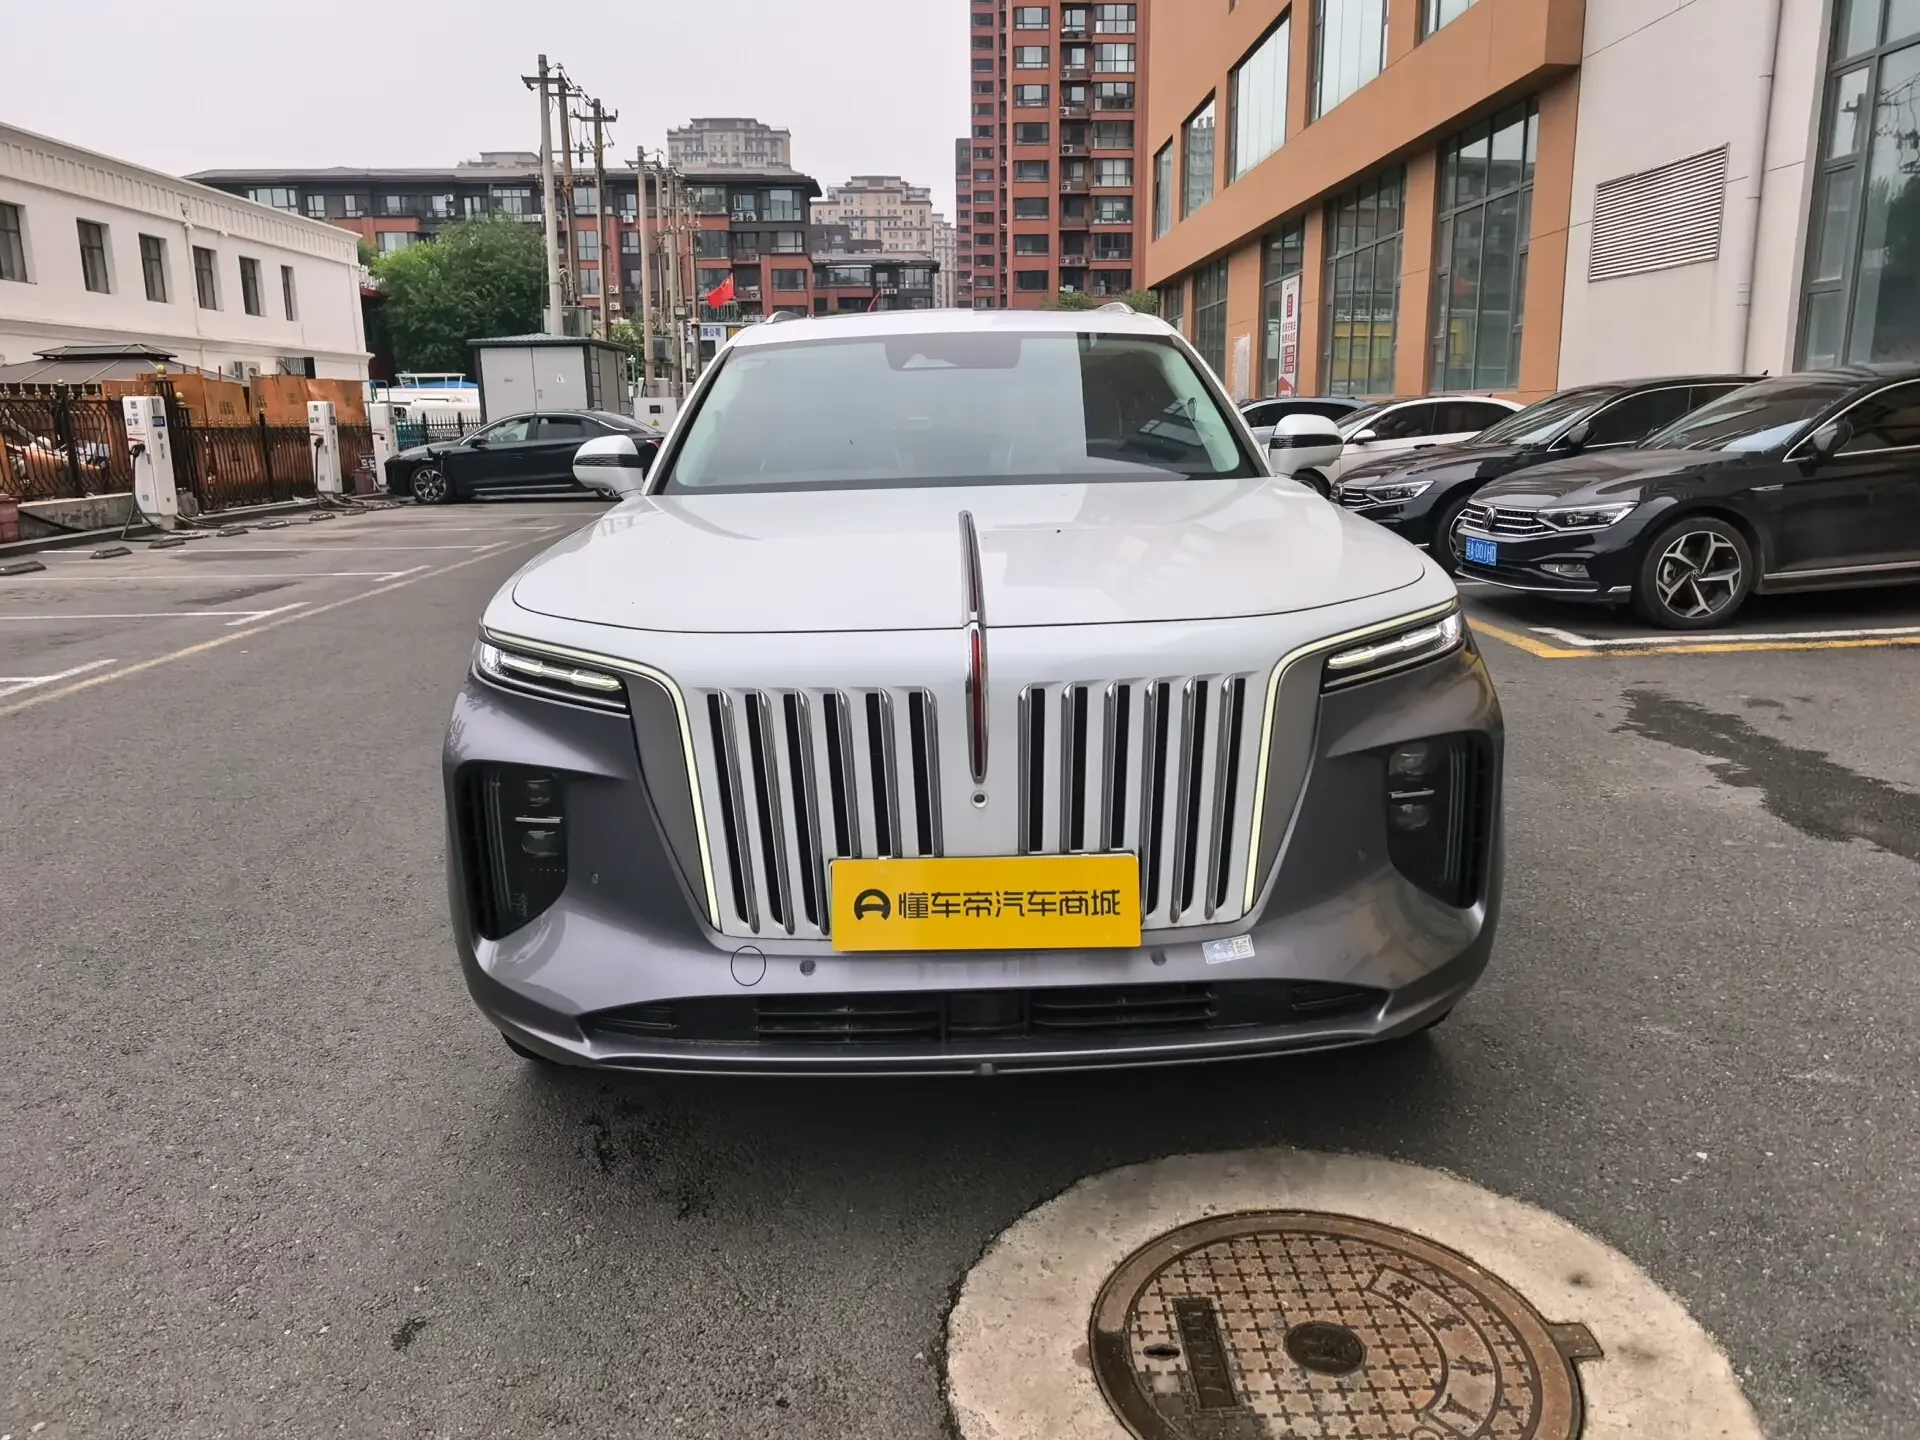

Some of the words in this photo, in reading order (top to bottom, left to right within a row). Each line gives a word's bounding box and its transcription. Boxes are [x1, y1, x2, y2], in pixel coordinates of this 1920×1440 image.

[898, 889, 1121, 919] 懂车帝汽车商城
